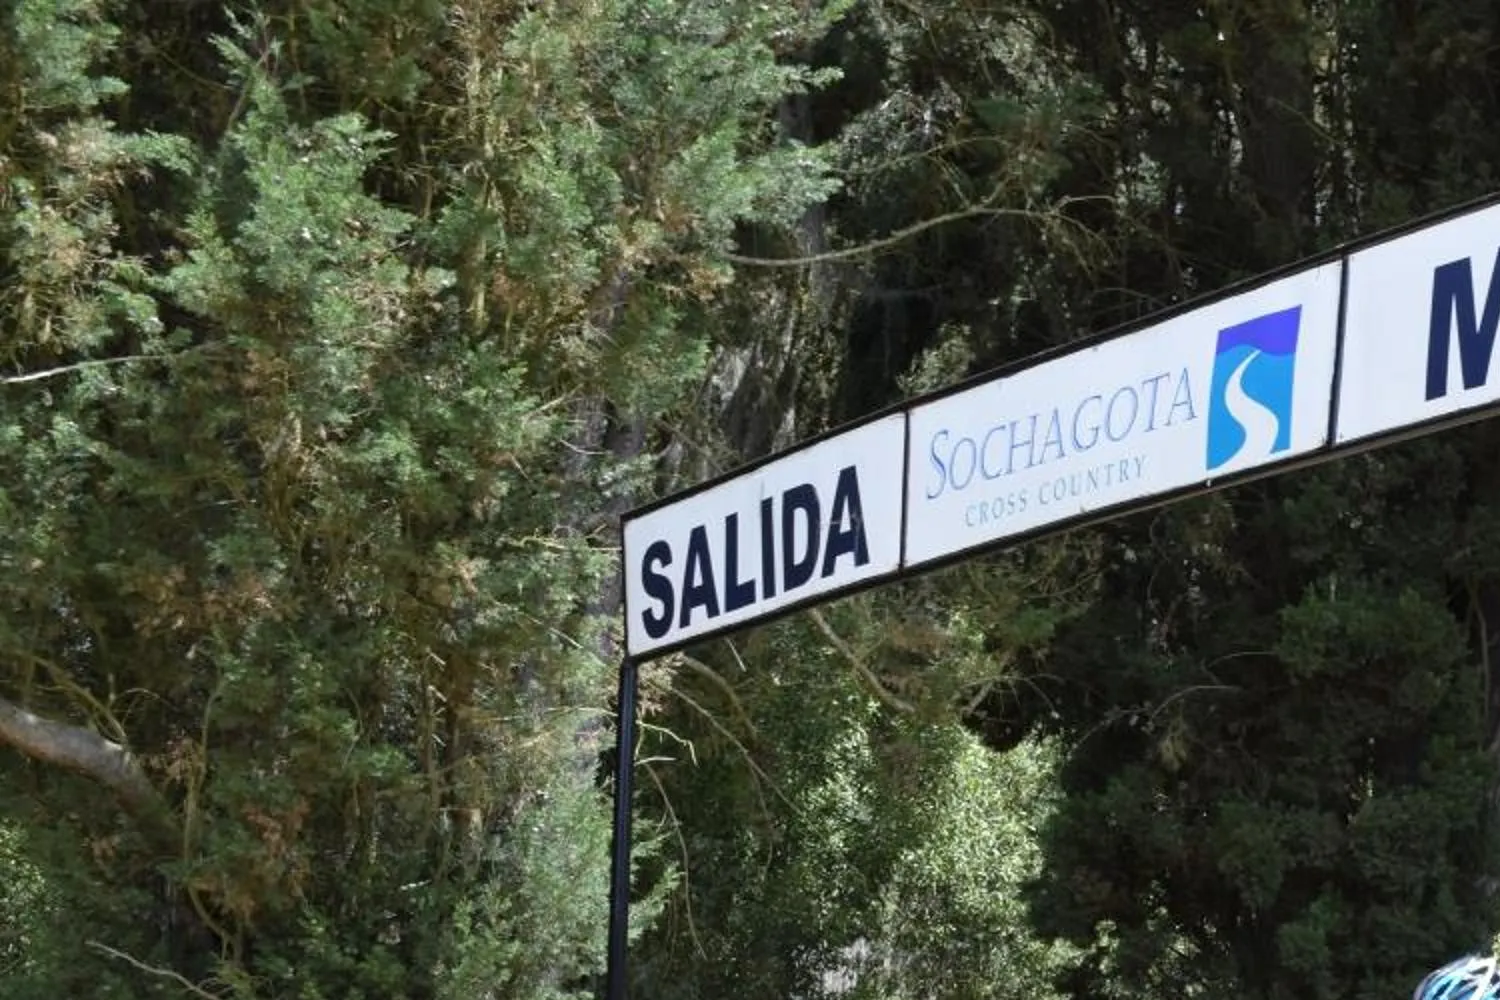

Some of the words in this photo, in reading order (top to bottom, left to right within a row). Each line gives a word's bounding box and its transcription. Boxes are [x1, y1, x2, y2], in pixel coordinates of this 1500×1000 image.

[926, 367, 1197, 499] SOCHAGOTA
[964, 488, 1028, 528] CROSS
[1038, 455, 1148, 506] COUNTRY
[640, 465, 870, 639] SALIDA
